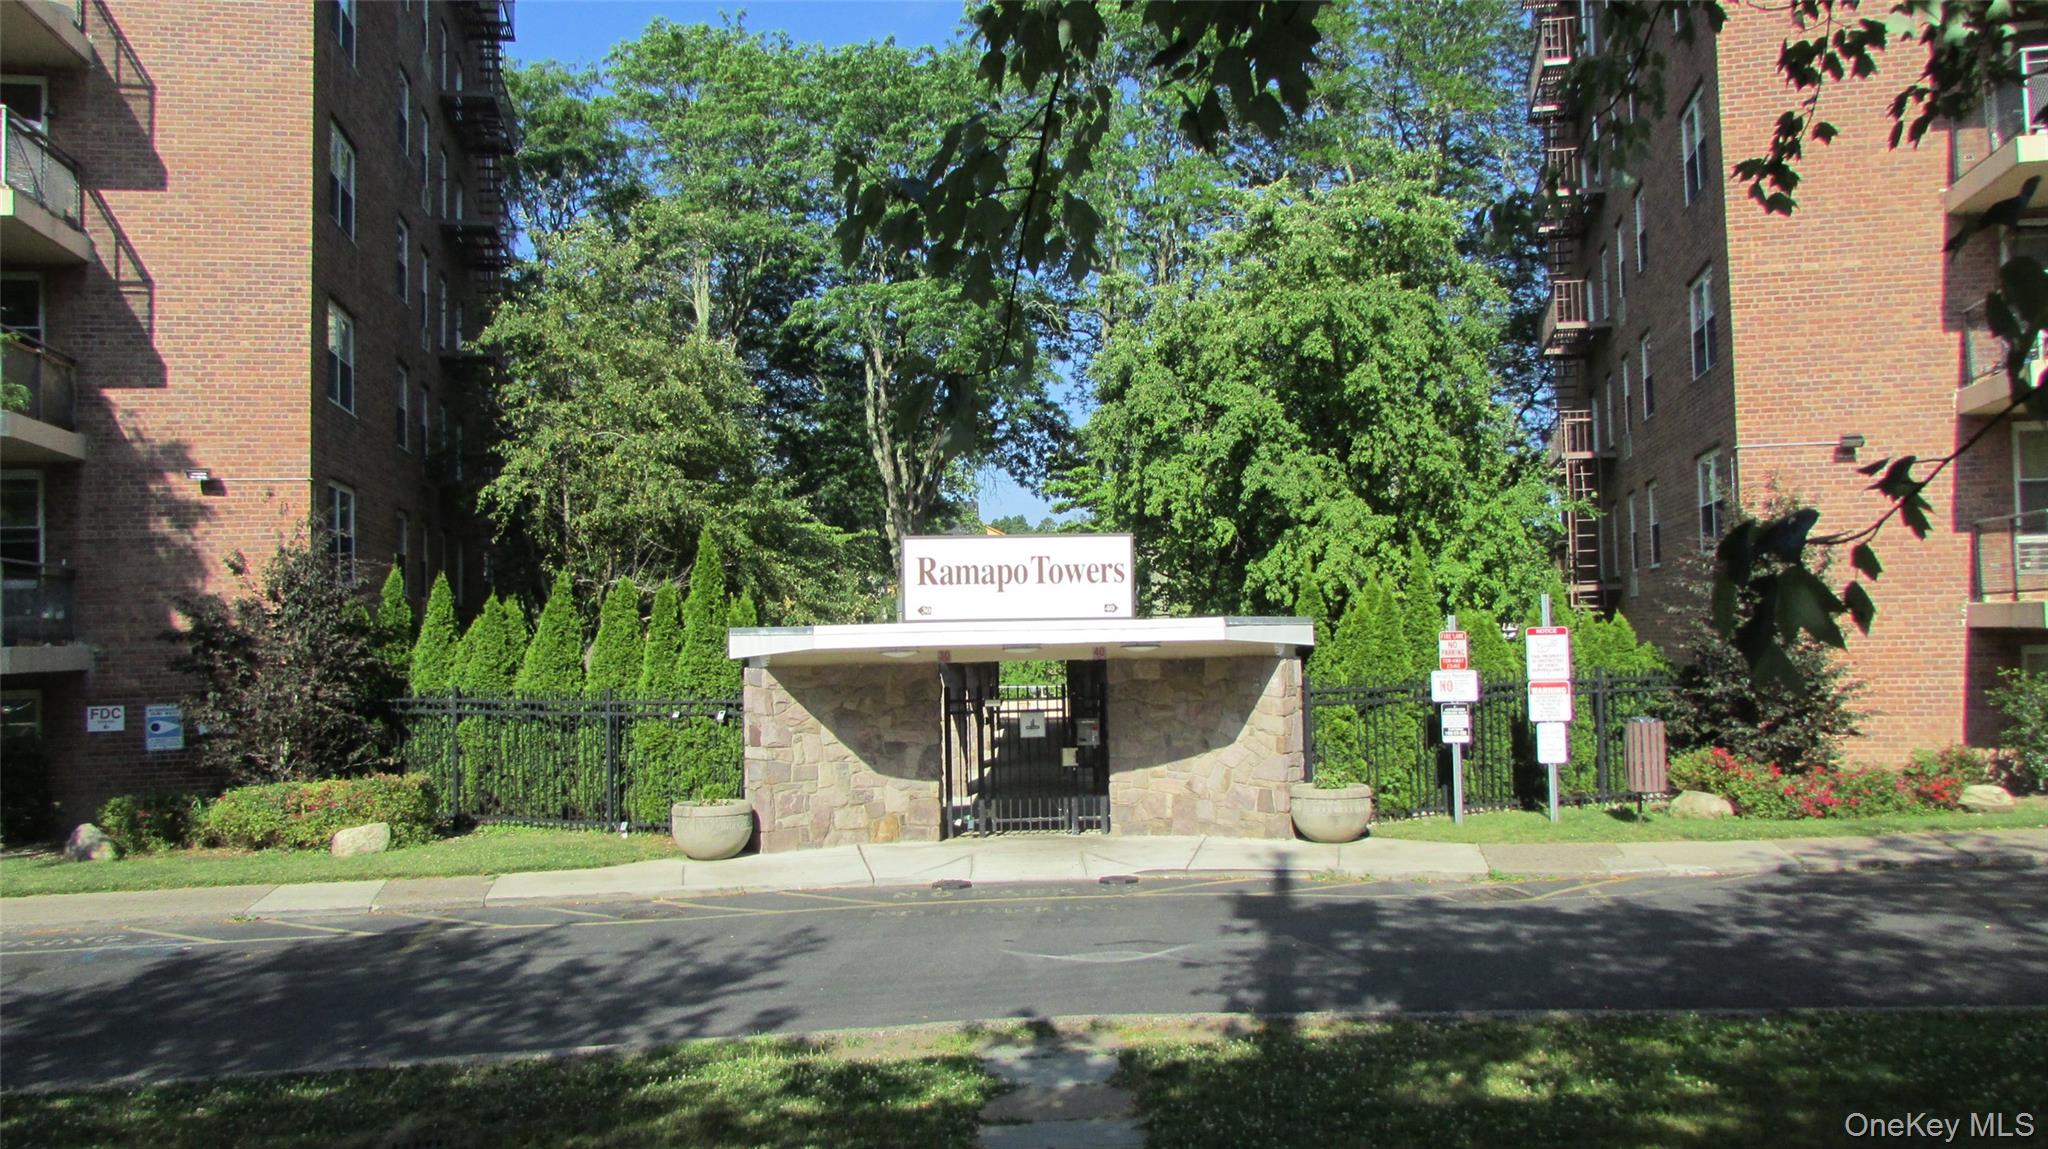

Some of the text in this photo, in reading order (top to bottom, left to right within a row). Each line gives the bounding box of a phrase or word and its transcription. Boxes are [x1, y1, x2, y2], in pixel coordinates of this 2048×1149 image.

[916, 555, 1125, 592] Ramapo Towers
[1440, 680, 1453, 692] NO
[90, 708, 121, 719] FDC
